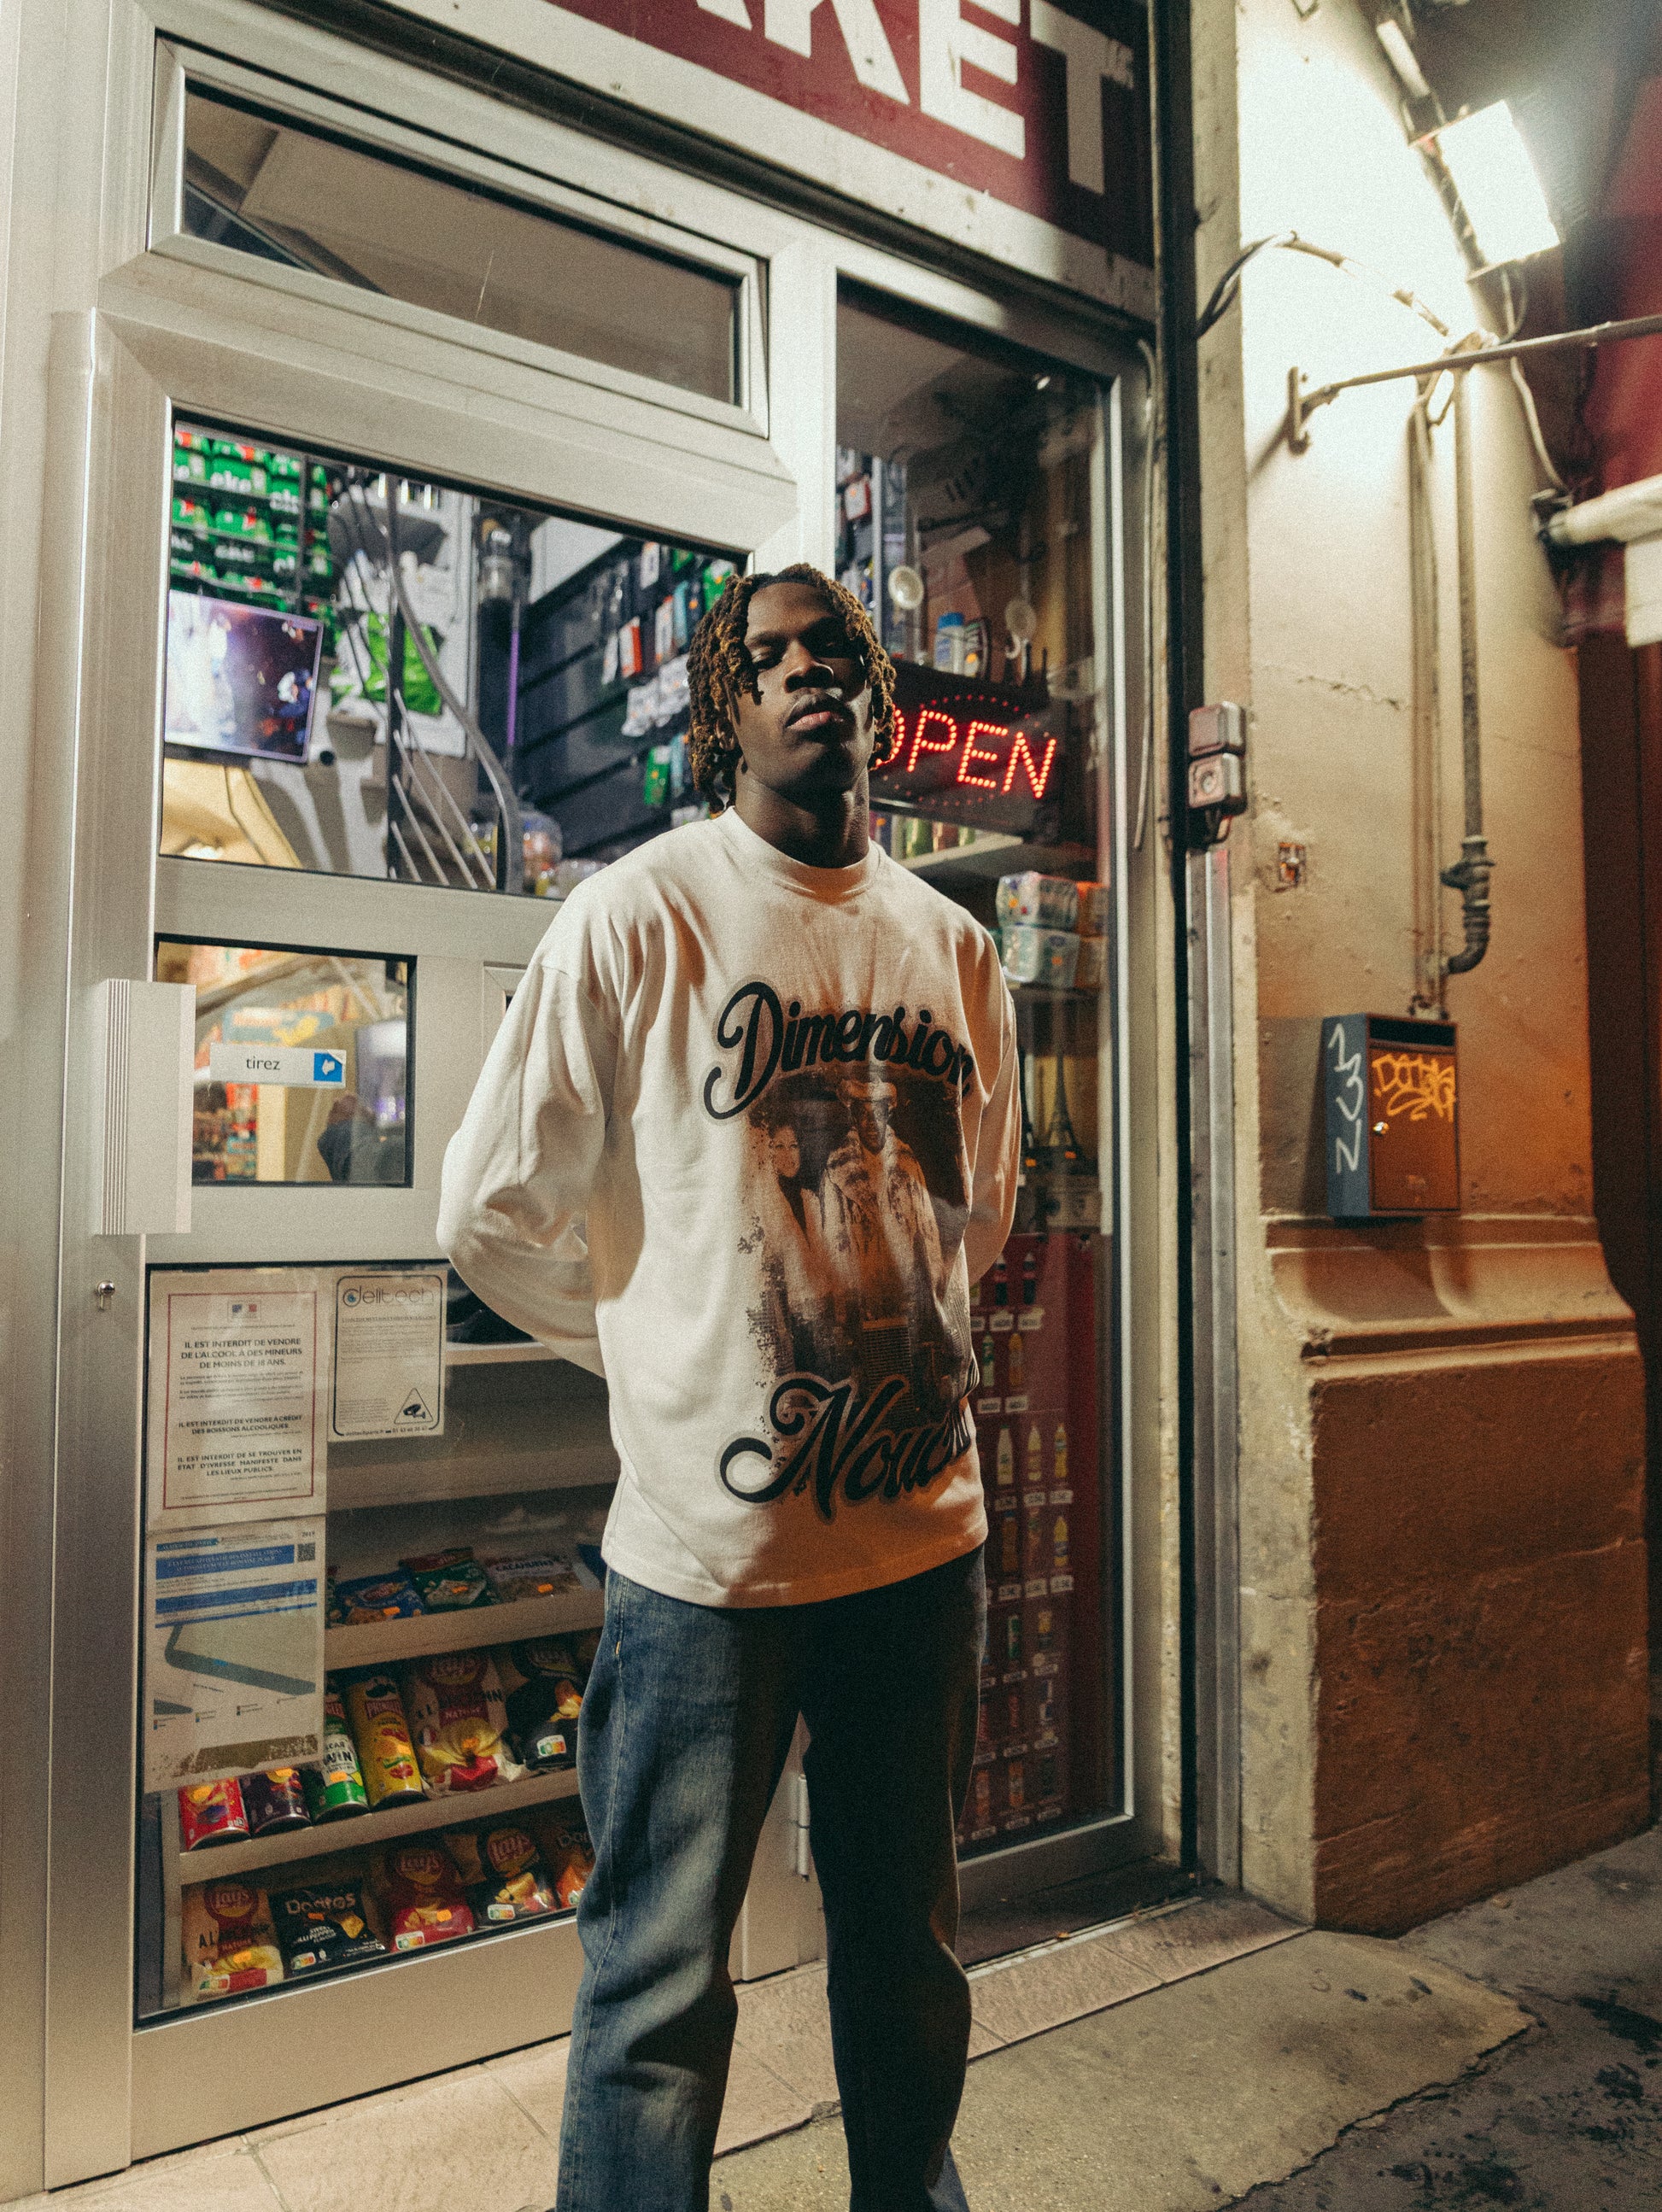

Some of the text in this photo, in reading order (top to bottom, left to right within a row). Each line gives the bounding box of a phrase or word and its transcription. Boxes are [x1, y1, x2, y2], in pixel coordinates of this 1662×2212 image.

[704, 981, 974, 1120] Dimension
[246, 1056, 281, 1071] tirez
[212, 1339, 252, 1348] INTERDIT
[267, 1337, 301, 1346] VENDRE
[181, 1351, 193, 1360] DE
[265, 1348, 302, 1356] MINEURS
[213, 1360, 242, 1368] MOINS
[200, 1419, 233, 1427] INTERDIT
[201, 1453, 235, 1461] INTERDIT
[258, 1448, 291, 1457] TROUVER
[239, 1457, 279, 1466] MANIFESTE
